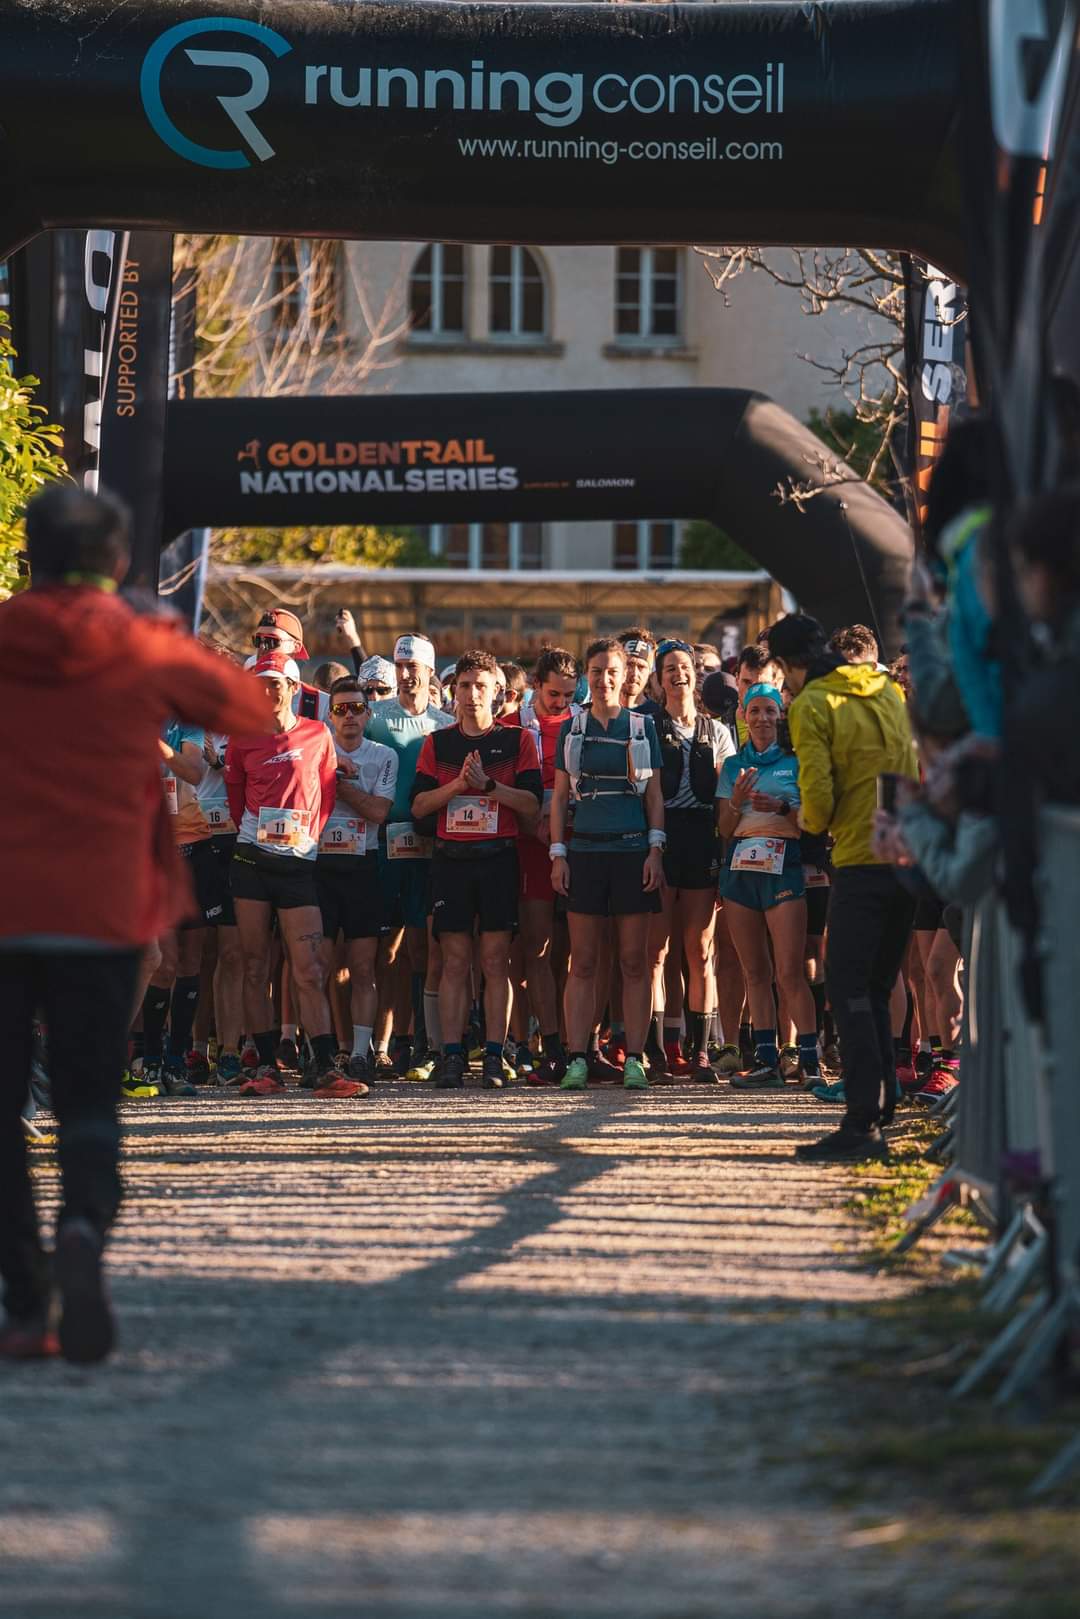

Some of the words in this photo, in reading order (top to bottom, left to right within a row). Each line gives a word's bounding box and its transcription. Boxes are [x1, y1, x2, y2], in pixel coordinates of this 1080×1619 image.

[457, 136, 783, 164] www.running-conseil.com
[124, 260, 139, 282] BY
[117, 292, 139, 416] SUPPORTED
[576, 478, 635, 488] SALOMON
[210, 811, 220, 823] 16
[463, 809, 473, 820] 14
[332, 831, 342, 842] 13
[750, 849, 756, 859] 3
